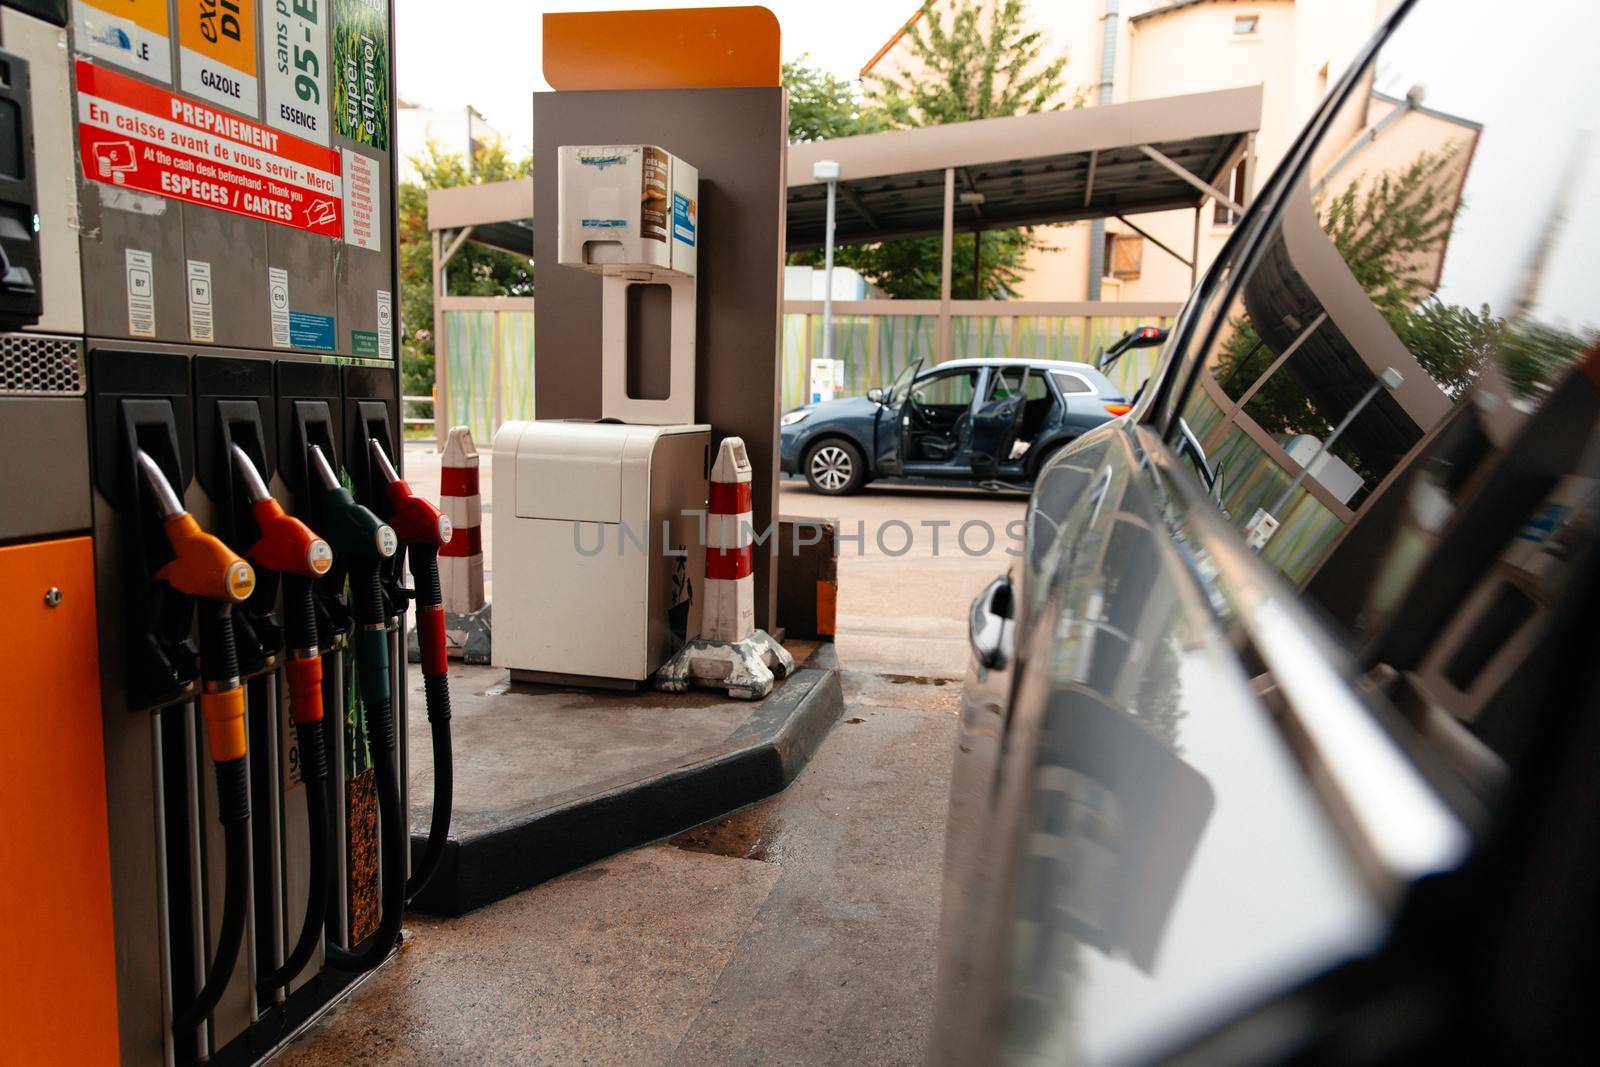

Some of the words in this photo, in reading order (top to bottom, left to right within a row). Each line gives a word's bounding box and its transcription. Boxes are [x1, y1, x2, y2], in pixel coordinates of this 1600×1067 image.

[276, 22, 289, 75] sans
[200, 69, 241, 99] GAZOLE
[347, 55, 361, 129] super
[361, 34, 376, 135] éthanol
[170, 98, 279, 153] PREPAIEMENT
[280, 104, 317, 131] ESSENCE
[89, 102, 109, 124] En
[116, 114, 165, 141] caisse
[171, 131, 209, 155] avant
[214, 141, 229, 160] de
[233, 151, 262, 170] vous
[266, 162, 297, 181] servir
[307, 171, 334, 192] Merci
[143, 147, 155, 161] At
[156, 150, 172, 166] the
[173, 157, 195, 172] cash
[196, 162, 217, 179] desk
[218, 168, 261, 191] beforehand
[268, 182, 289, 199] Thank
[290, 190, 303, 202] you
[161, 171, 229, 205] ESPECES
[233, 190, 239, 207] /
[243, 193, 293, 221] CARTES
[135, 279, 145, 287] B7
[195, 287, 204, 296] B7
[274, 293, 284, 302] E10
